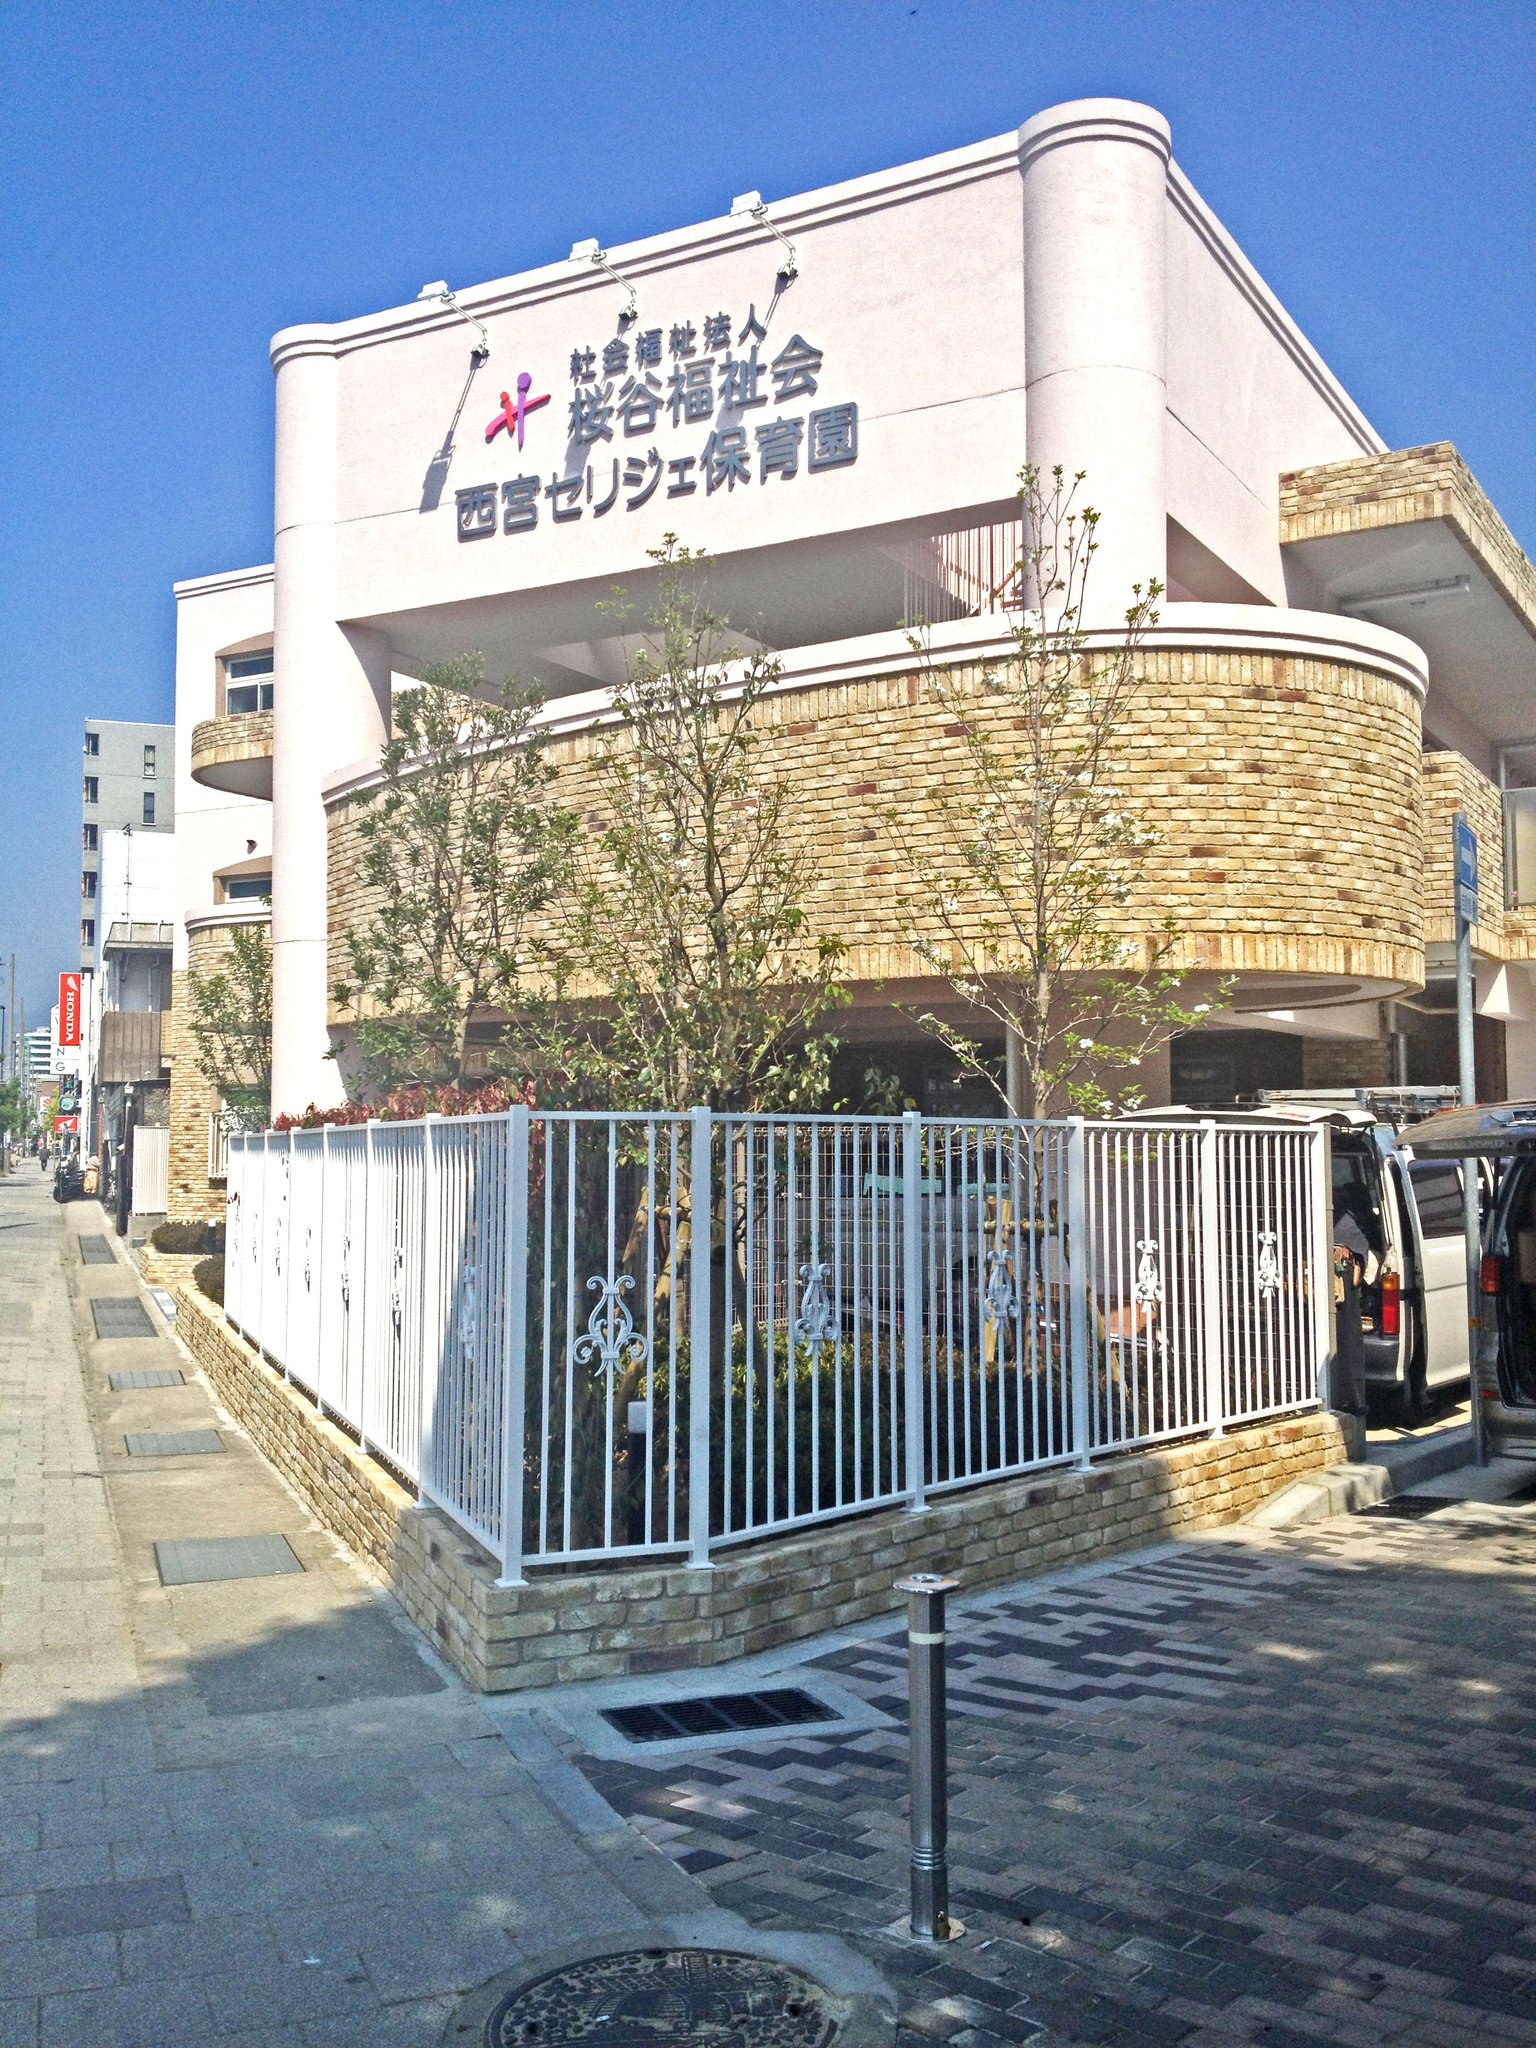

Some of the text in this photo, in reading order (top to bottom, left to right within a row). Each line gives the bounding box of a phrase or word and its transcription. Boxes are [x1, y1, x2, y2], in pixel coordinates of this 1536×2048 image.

[569, 303, 767, 385] 社会福祉法人
[568, 334, 823, 444] 桜谷福祉会
[66, 991, 75, 1043] HONDA
